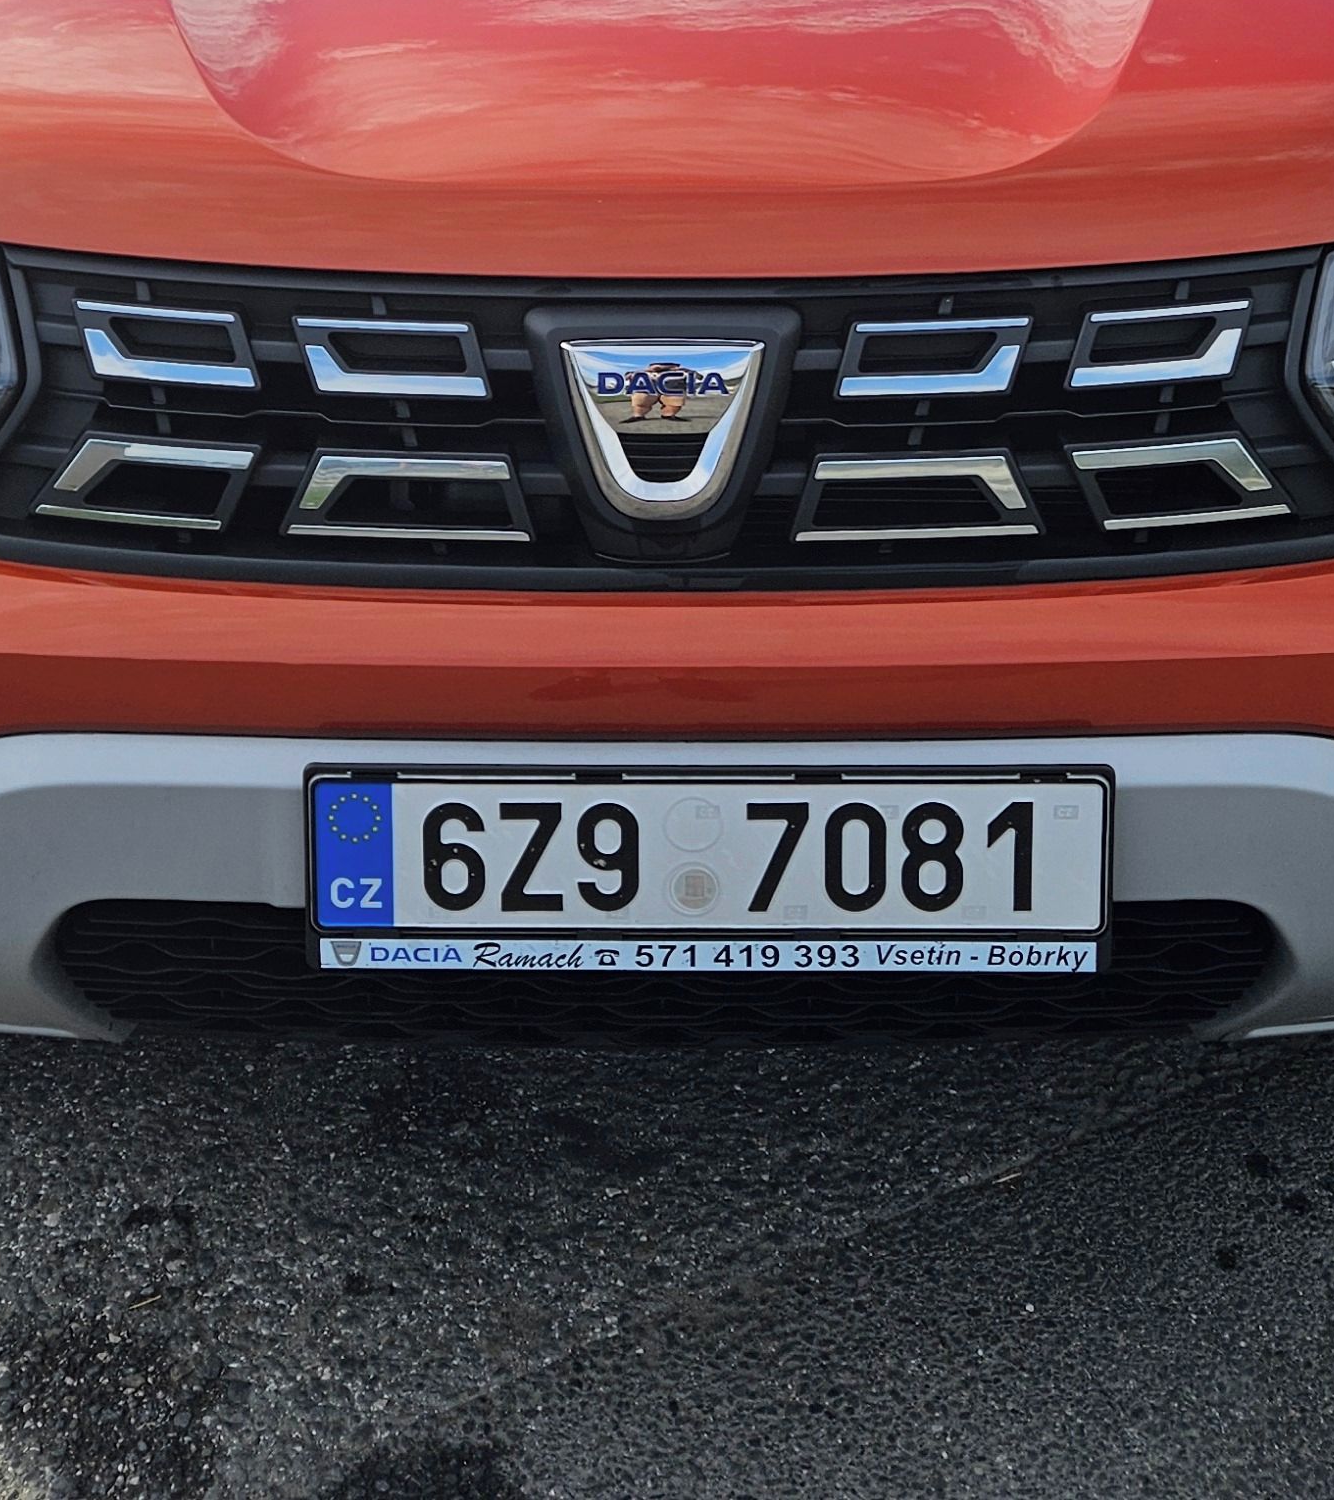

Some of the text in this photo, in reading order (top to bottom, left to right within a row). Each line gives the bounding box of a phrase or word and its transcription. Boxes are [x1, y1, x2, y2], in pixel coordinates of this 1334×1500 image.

[597, 371, 729, 396] DACIA
[422, 801, 1034, 912] 6Z9 7081
[330, 877, 383, 909] CZ
[370, 946, 463, 963] DACIA
[473, 942, 585, 968] Ramach
[634, 945, 698, 967] 571
[713, 945, 780, 968] 419
[793, 945, 861, 968] 393
[987, 946, 1088, 970] Bobrky
